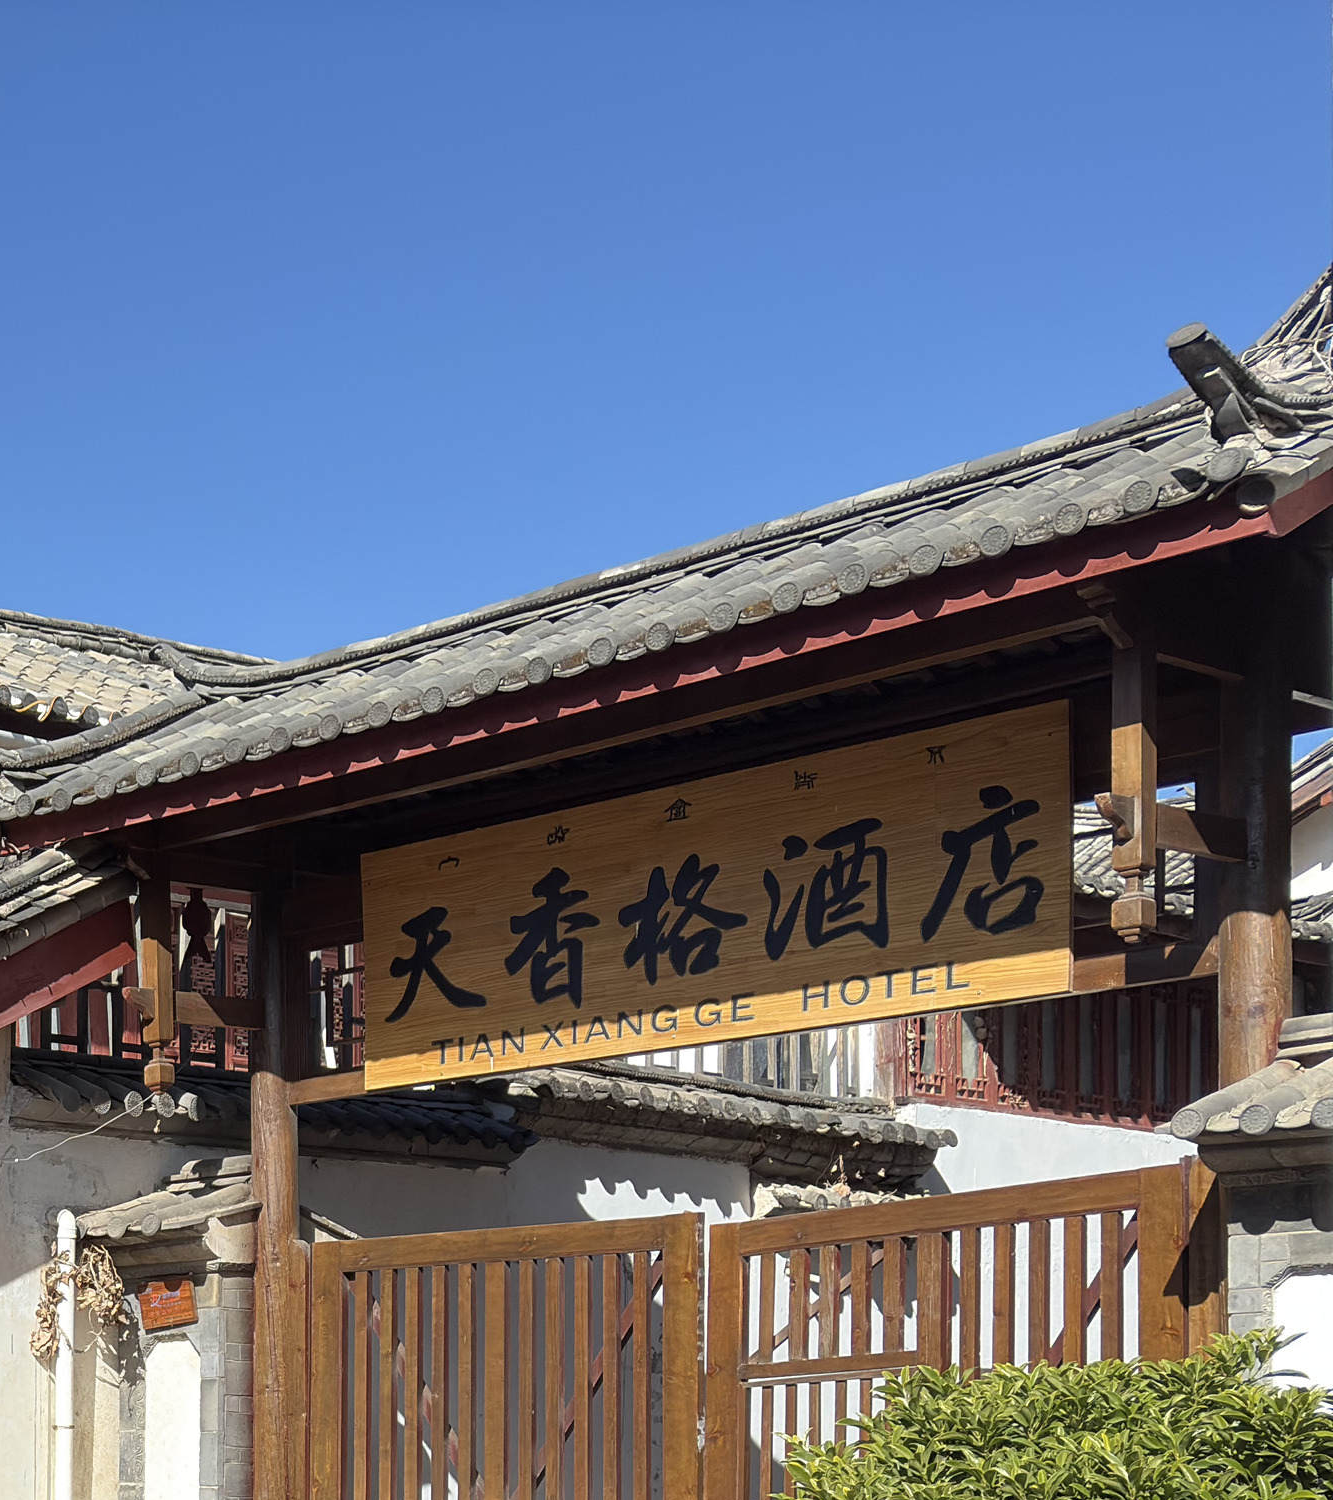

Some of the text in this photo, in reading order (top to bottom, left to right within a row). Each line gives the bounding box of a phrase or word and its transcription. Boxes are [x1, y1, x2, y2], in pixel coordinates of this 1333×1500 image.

[385, 785, 1045, 1023] 天香格酒店
[431, 961, 970, 1066] TIAN XIANG GE HOTEL
